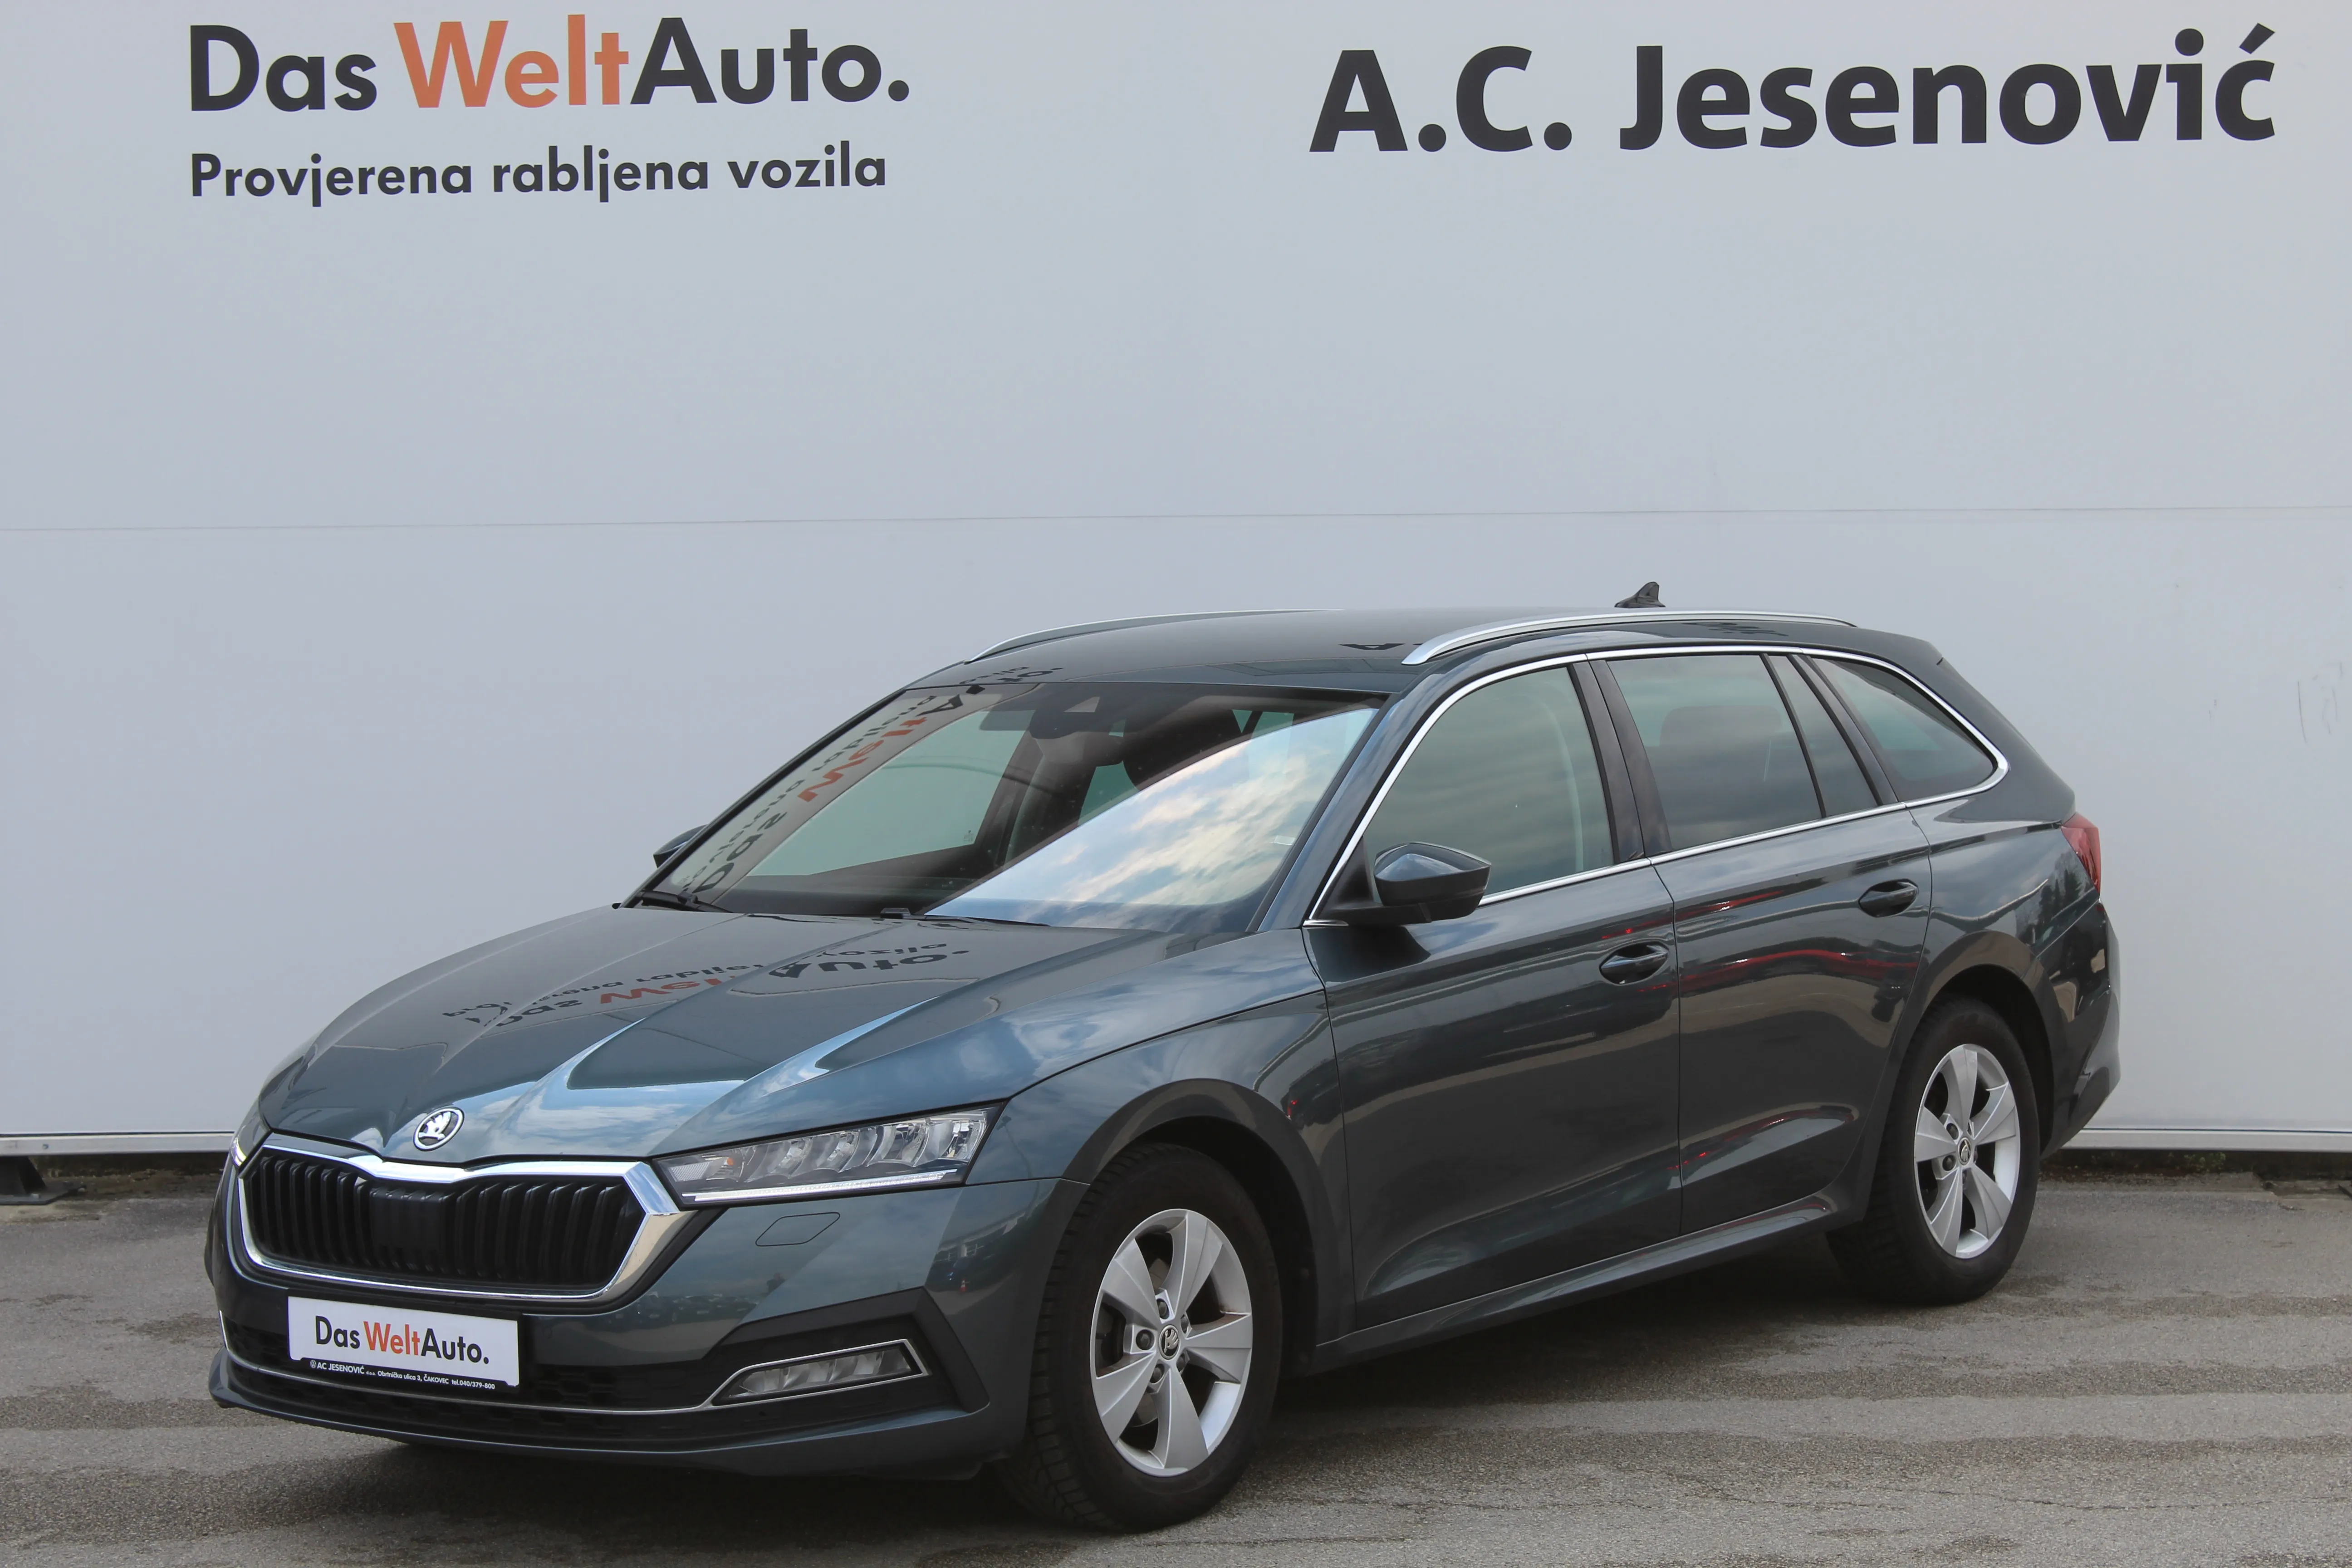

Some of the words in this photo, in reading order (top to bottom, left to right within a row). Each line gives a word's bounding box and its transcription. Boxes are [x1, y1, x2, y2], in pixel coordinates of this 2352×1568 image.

[190, 24, 377, 112] Das
[393, 14, 909, 108] WeltAuto.
[1309, 45, 1572, 152] A.C.
[1620, 22, 2275, 151] Jesenović
[191, 153, 471, 207] Provjerena
[493, 145, 708, 203] rabljena
[727, 140, 886, 189] vozila
[315, 1315, 360, 1349] Das
[363, 1321, 489, 1365] WeltAuto.
[317, 1362, 327, 1370] AC
[328, 1363, 365, 1374] JESENOVIĆ
[377, 1370, 402, 1379] Obrtnička
[423, 1374, 449, 1384] ČAKOVEC
